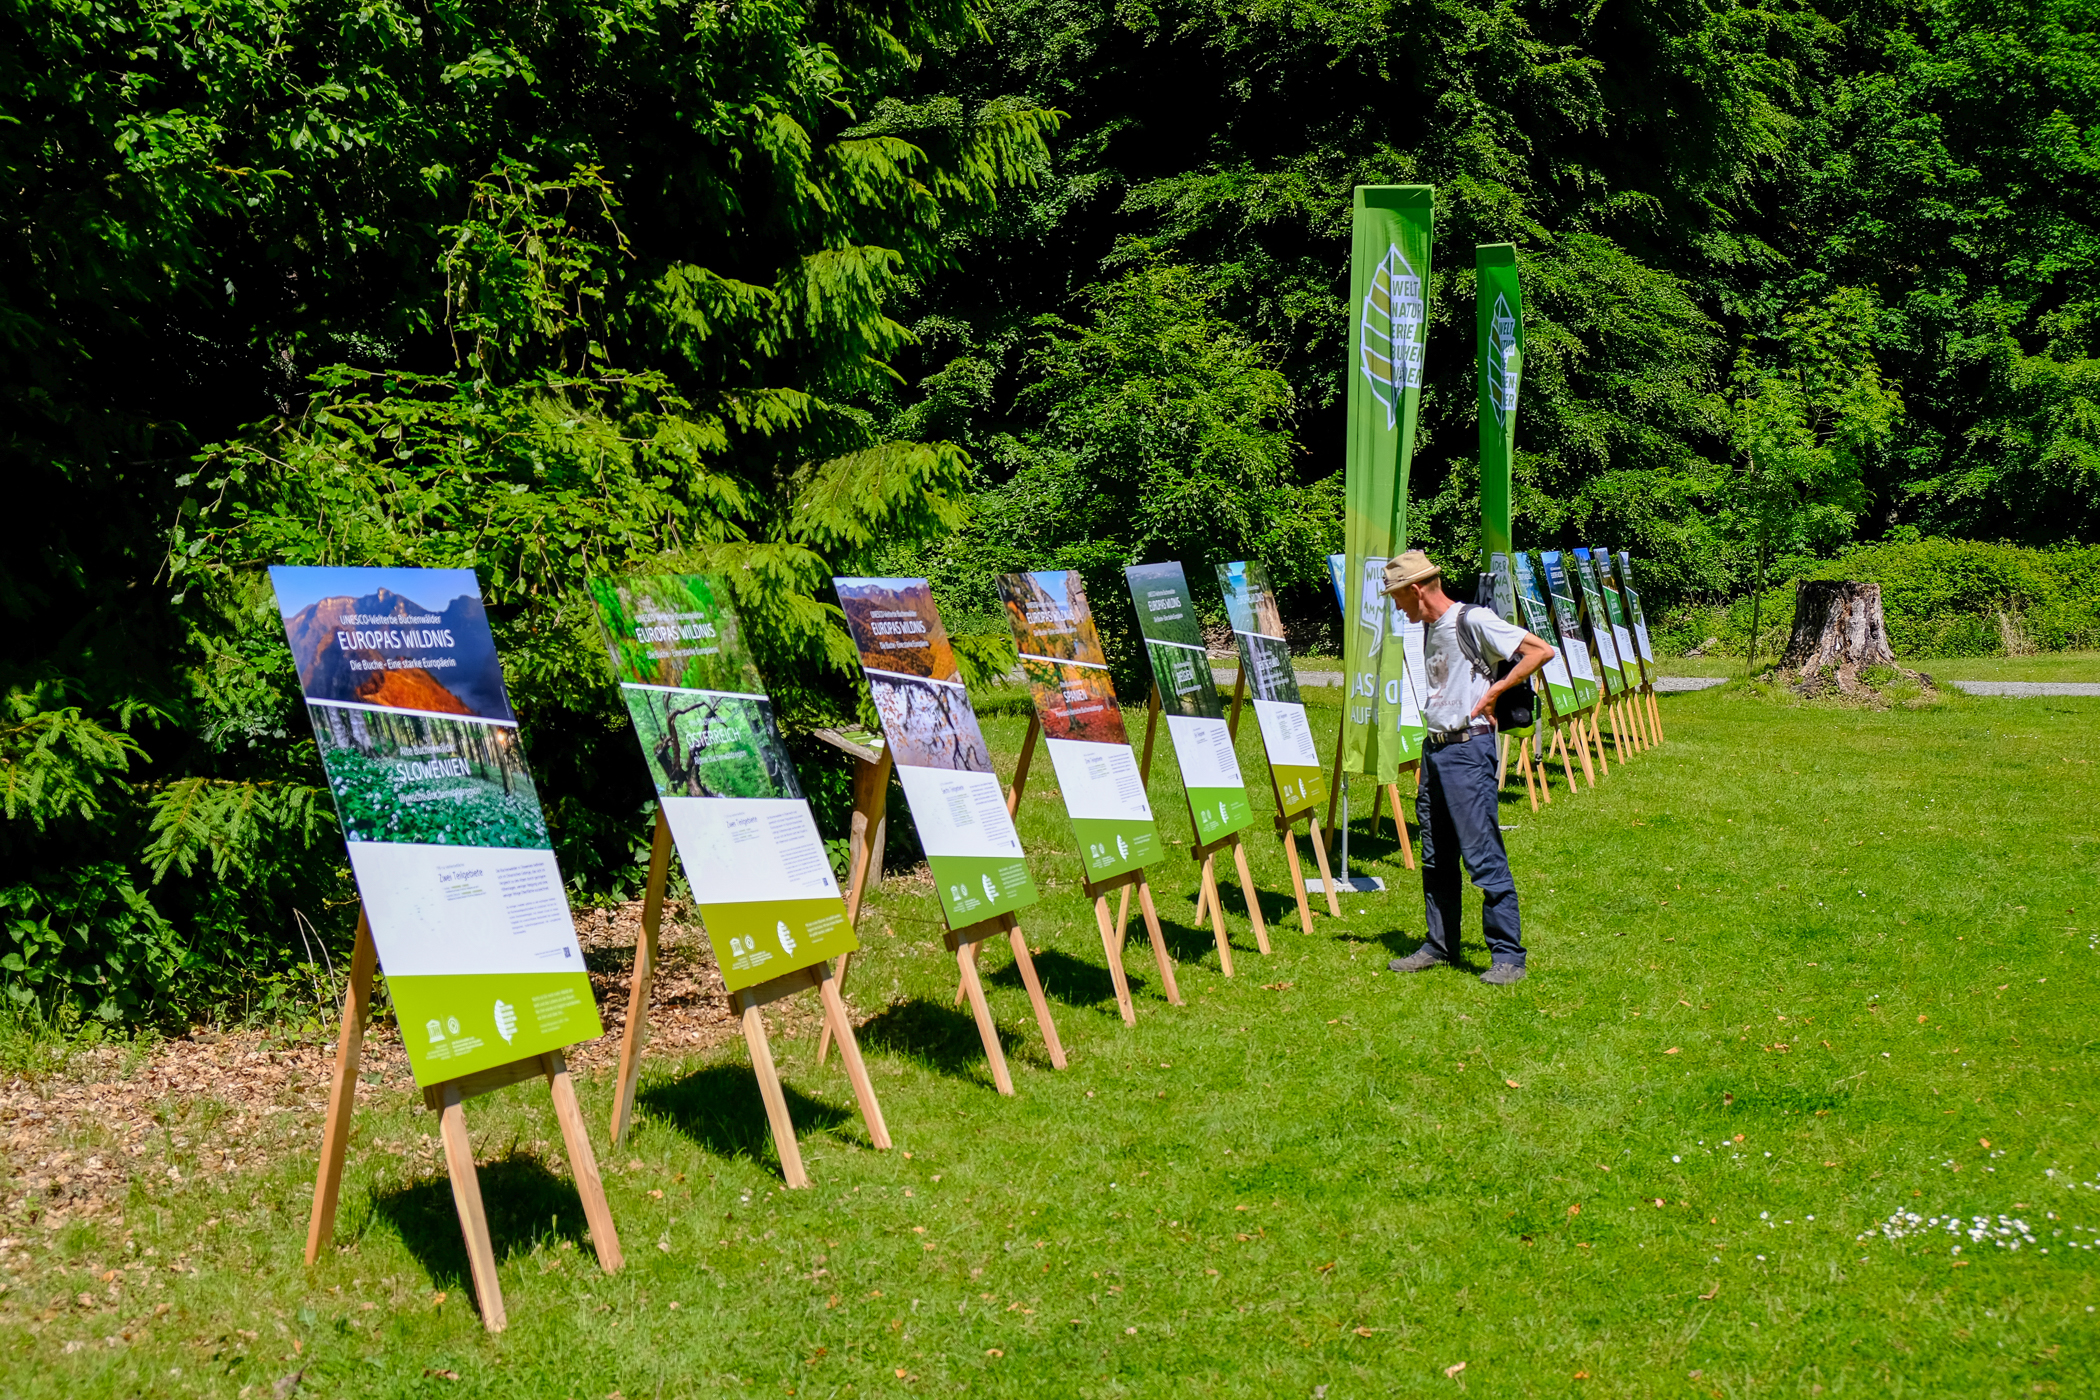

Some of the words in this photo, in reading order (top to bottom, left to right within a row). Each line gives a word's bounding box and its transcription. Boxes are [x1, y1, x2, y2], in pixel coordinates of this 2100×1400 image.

[1392, 280, 1418, 297] WELT
[1391, 301, 1422, 319] NATUR
[339, 613, 397, 626] UNESCO-Welterbe
[398, 612, 441, 625] Buchenwälder
[337, 629, 402, 650] EUROPAS
[400, 628, 456, 649] WILDNIS
[635, 625, 680, 644] EUROPAS
[678, 623, 717, 640] WILDNIS
[349, 659, 362, 671] Die
[362, 658, 384, 671] Buche
[386, 658, 402, 670] Eine
[402, 657, 423, 669] starke
[422, 656, 457, 670] Europäerin
[396, 757, 472, 782] SLOWENIEN
[438, 873, 452, 883] Zwei
[452, 869, 483, 881] Teilgebiete
